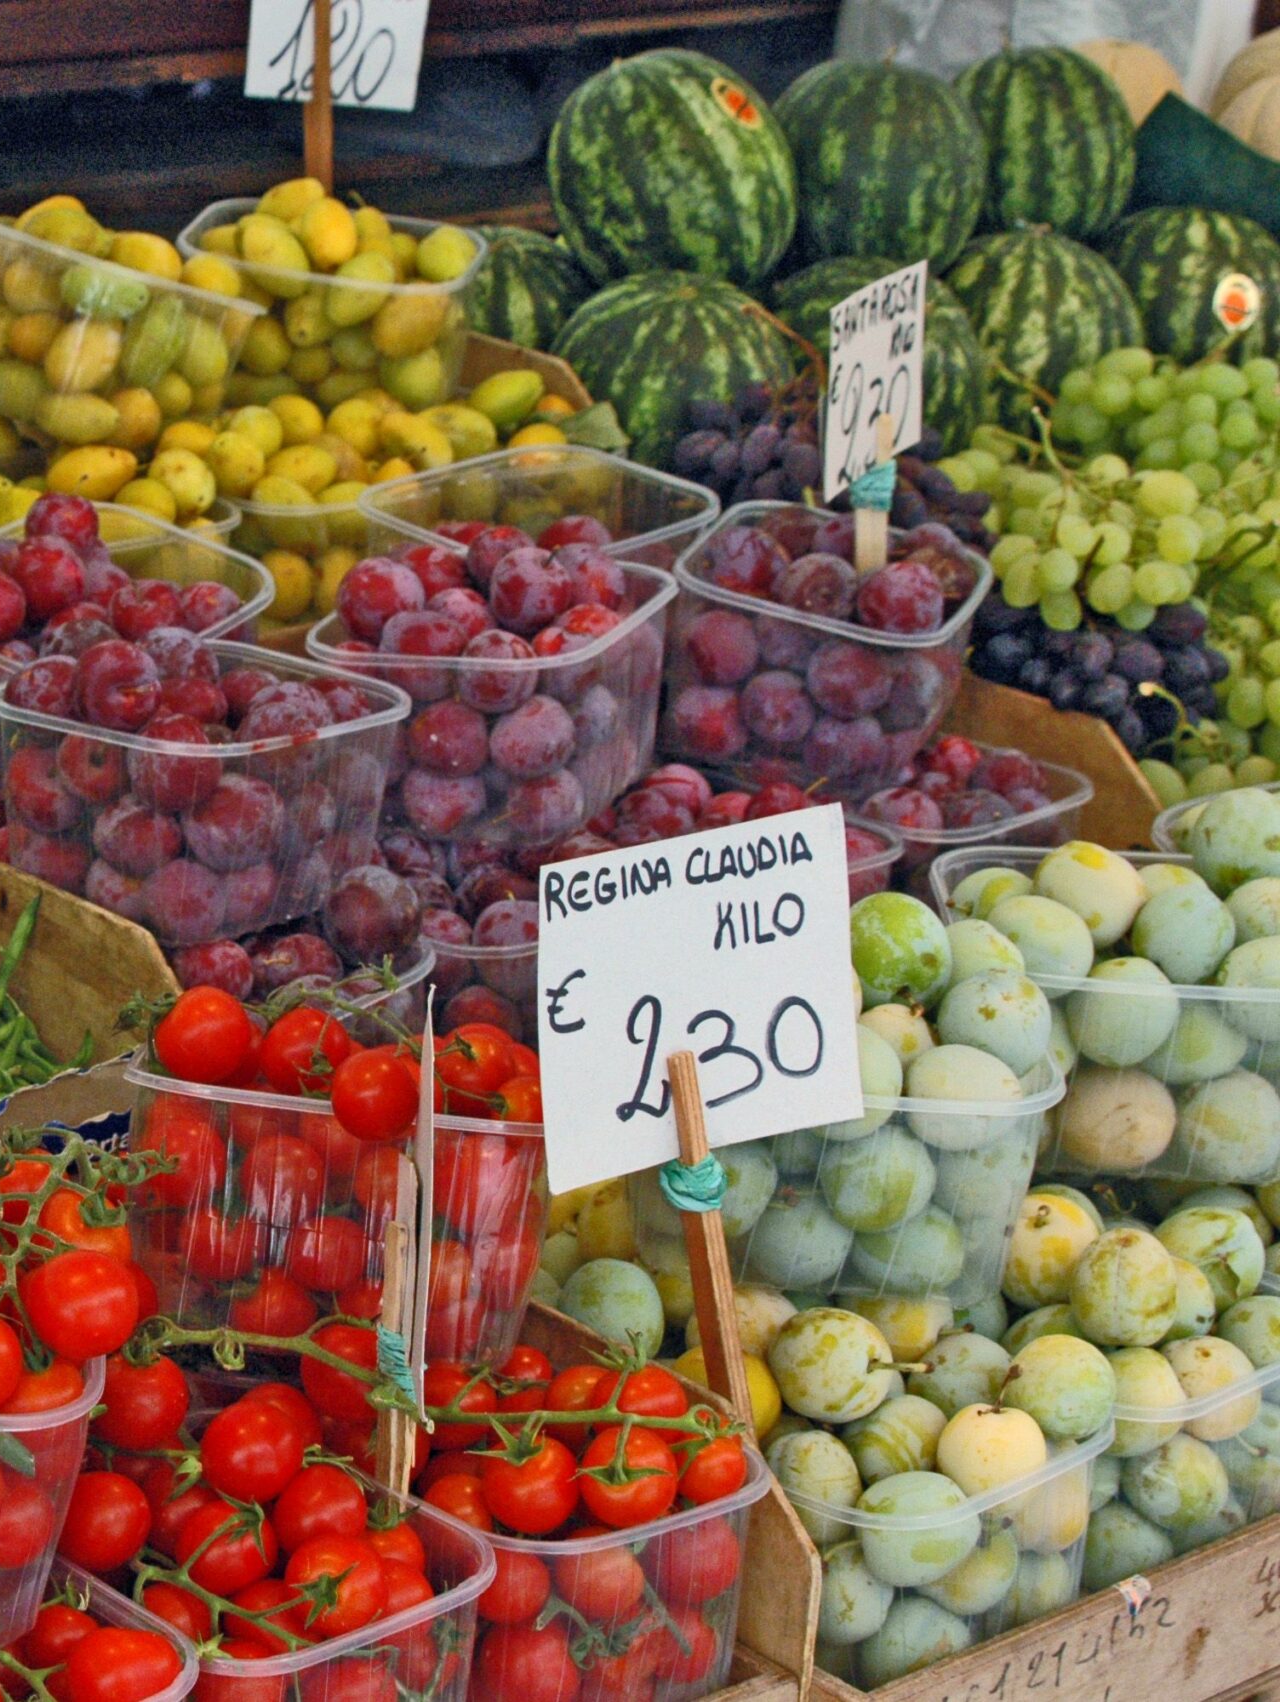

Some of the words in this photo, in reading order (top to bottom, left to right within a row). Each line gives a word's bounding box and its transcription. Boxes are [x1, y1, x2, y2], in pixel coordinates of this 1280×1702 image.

[544, 856, 671, 923] REGINA
[685, 831, 813, 886] CLAUDIA
[713, 892, 805, 950] KILO
